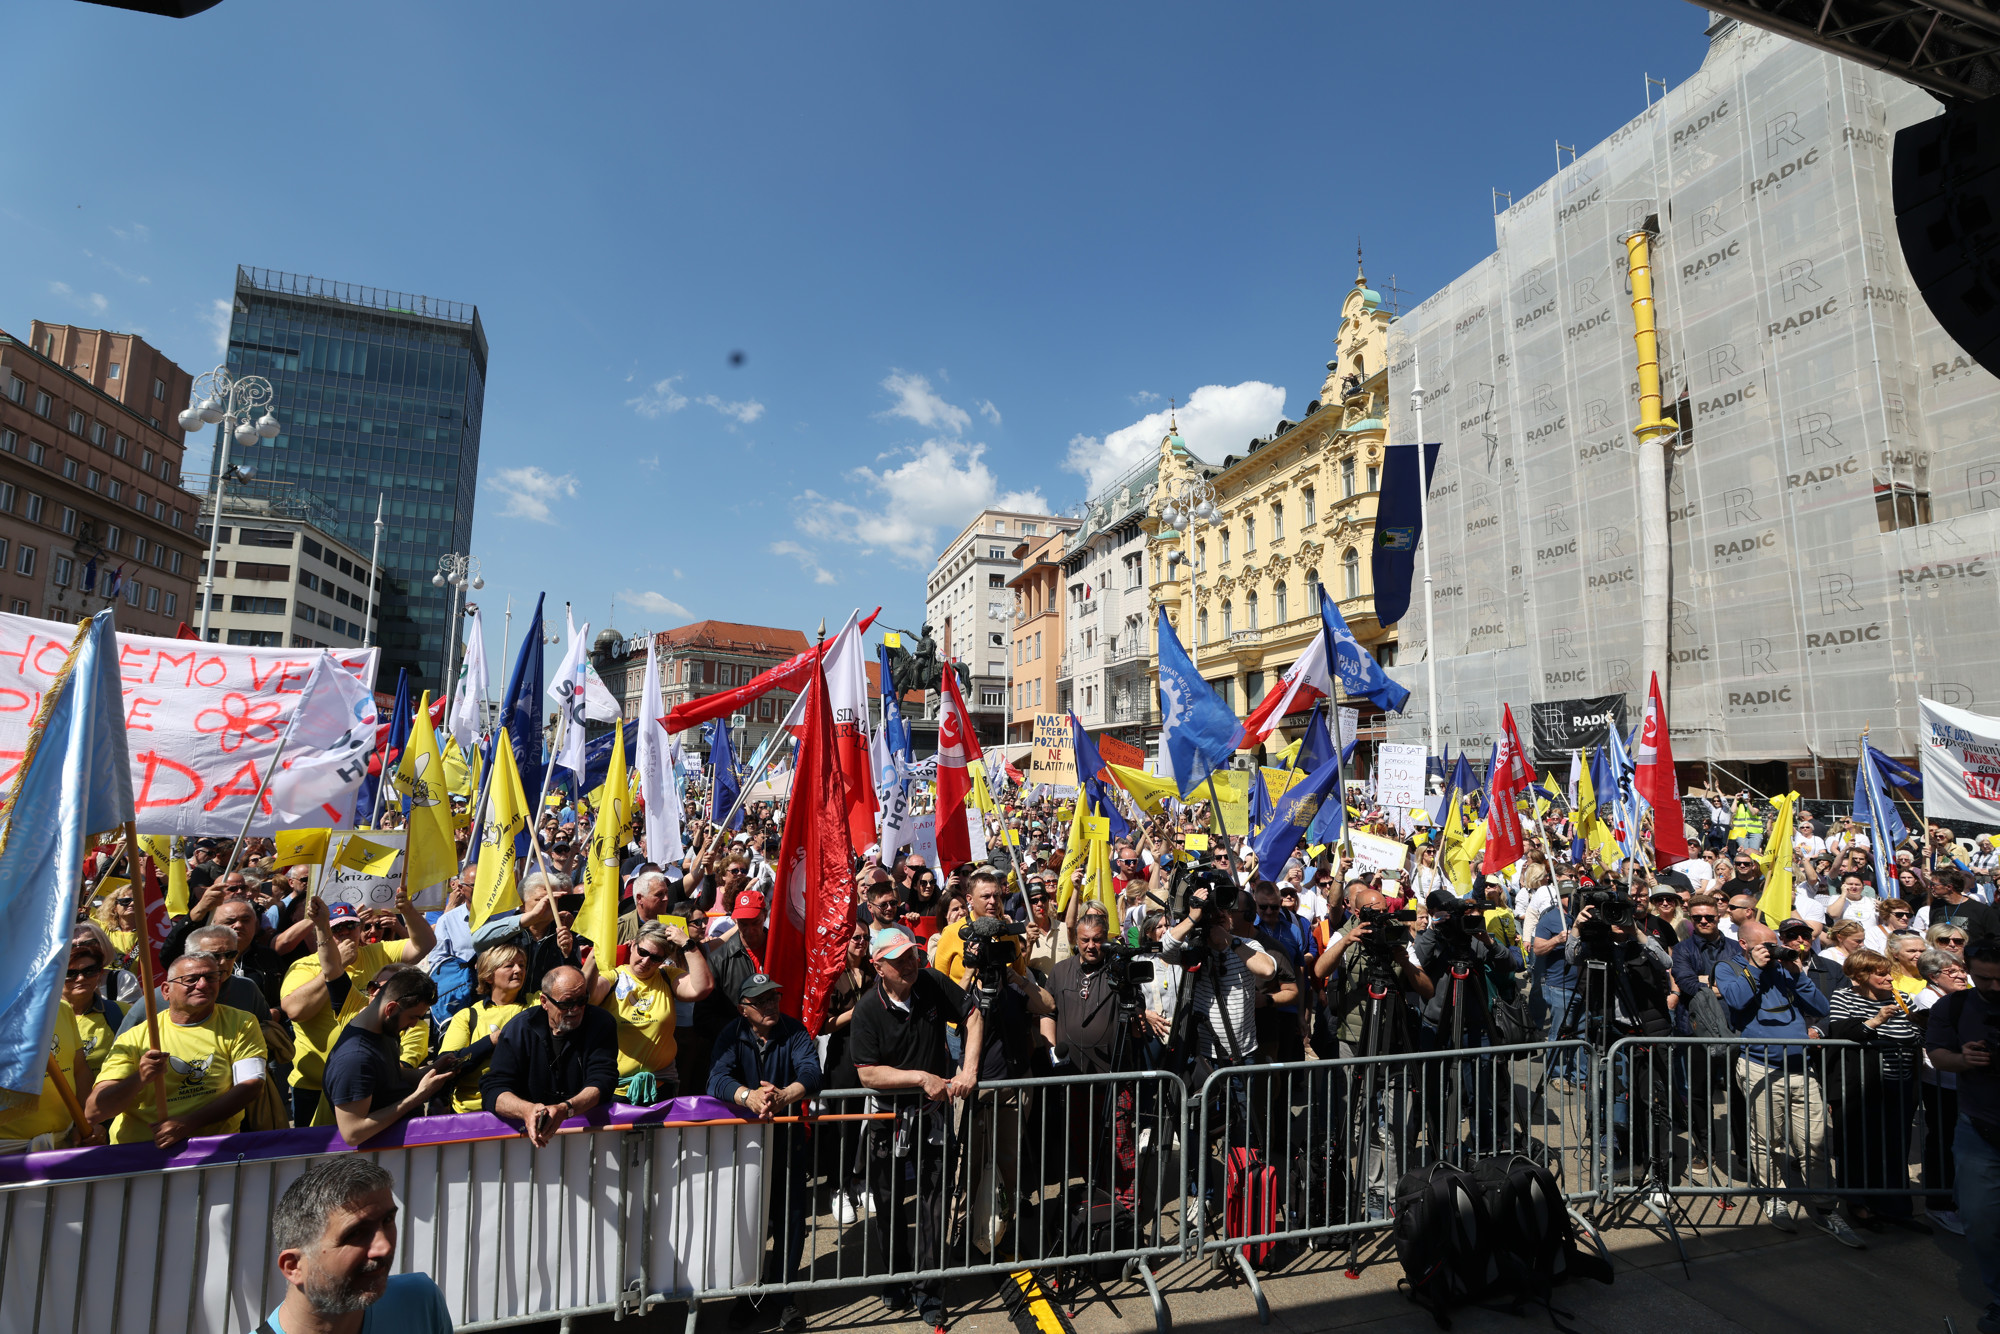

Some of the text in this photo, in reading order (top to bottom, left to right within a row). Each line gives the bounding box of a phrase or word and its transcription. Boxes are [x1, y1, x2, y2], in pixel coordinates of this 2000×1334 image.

[1610, 103, 1659, 146] RADIĆ
[1673, 100, 1729, 144] RADIĆ
[1765, 111, 1806, 160] R
[1843, 127, 1885, 150] RADIĆ
[1750, 146, 1819, 195] RADIĆ
[1558, 187, 1601, 222] RADIĆ
[1692, 206, 1727, 247] R
[1683, 239, 1740, 279] RADIĆ
[1779, 258, 1823, 303] R
[1455, 305, 1486, 333] RADIĆ
[1515, 301, 1556, 329] RADIĆ
[1567, 307, 1612, 339] RADIĆ
[1768, 296, 1838, 337] RADIĆ
[1708, 343, 1744, 384] R
[1423, 382, 1450, 406] RADIĆ
[1698, 382, 1756, 415] RADIĆ
[1526, 416, 1566, 442] RADIĆ
[1797, 412, 1842, 456] R
[1579, 433, 1625, 460] RADIĆ
[1786, 456, 1859, 489] RADIĆ
[1724, 487, 1762, 527] R
[1467, 515, 1498, 533] RADIĆ
[1537, 538, 1577, 561] RADIĆ
[1714, 530, 1776, 558] RADIĆ
[1588, 566, 1635, 588] RADIĆ
[1898, 557, 1987, 585] RADIĆ
[1819, 573, 1863, 616] R
[1471, 622, 1504, 637] RADIĆ
[1807, 622, 1881, 648] RADIĆ
[0, 634, 227, 688] HOEMO
[1669, 645, 1710, 664] ADIĆ
[1741, 638, 1778, 677] R
[1545, 668, 1586, 684] RADIĆ
[1160, 664, 1193, 723] DIKAT METALACA
[1729, 685, 1792, 706] RADIĆ
[1037, 715, 1060, 727] NAS
[1040, 727, 1068, 736] TREBA
[1048, 749, 1061, 761] NE
[1382, 746, 1423, 755] NETO SAT
[1033, 760, 1066, 771] BLATITI
